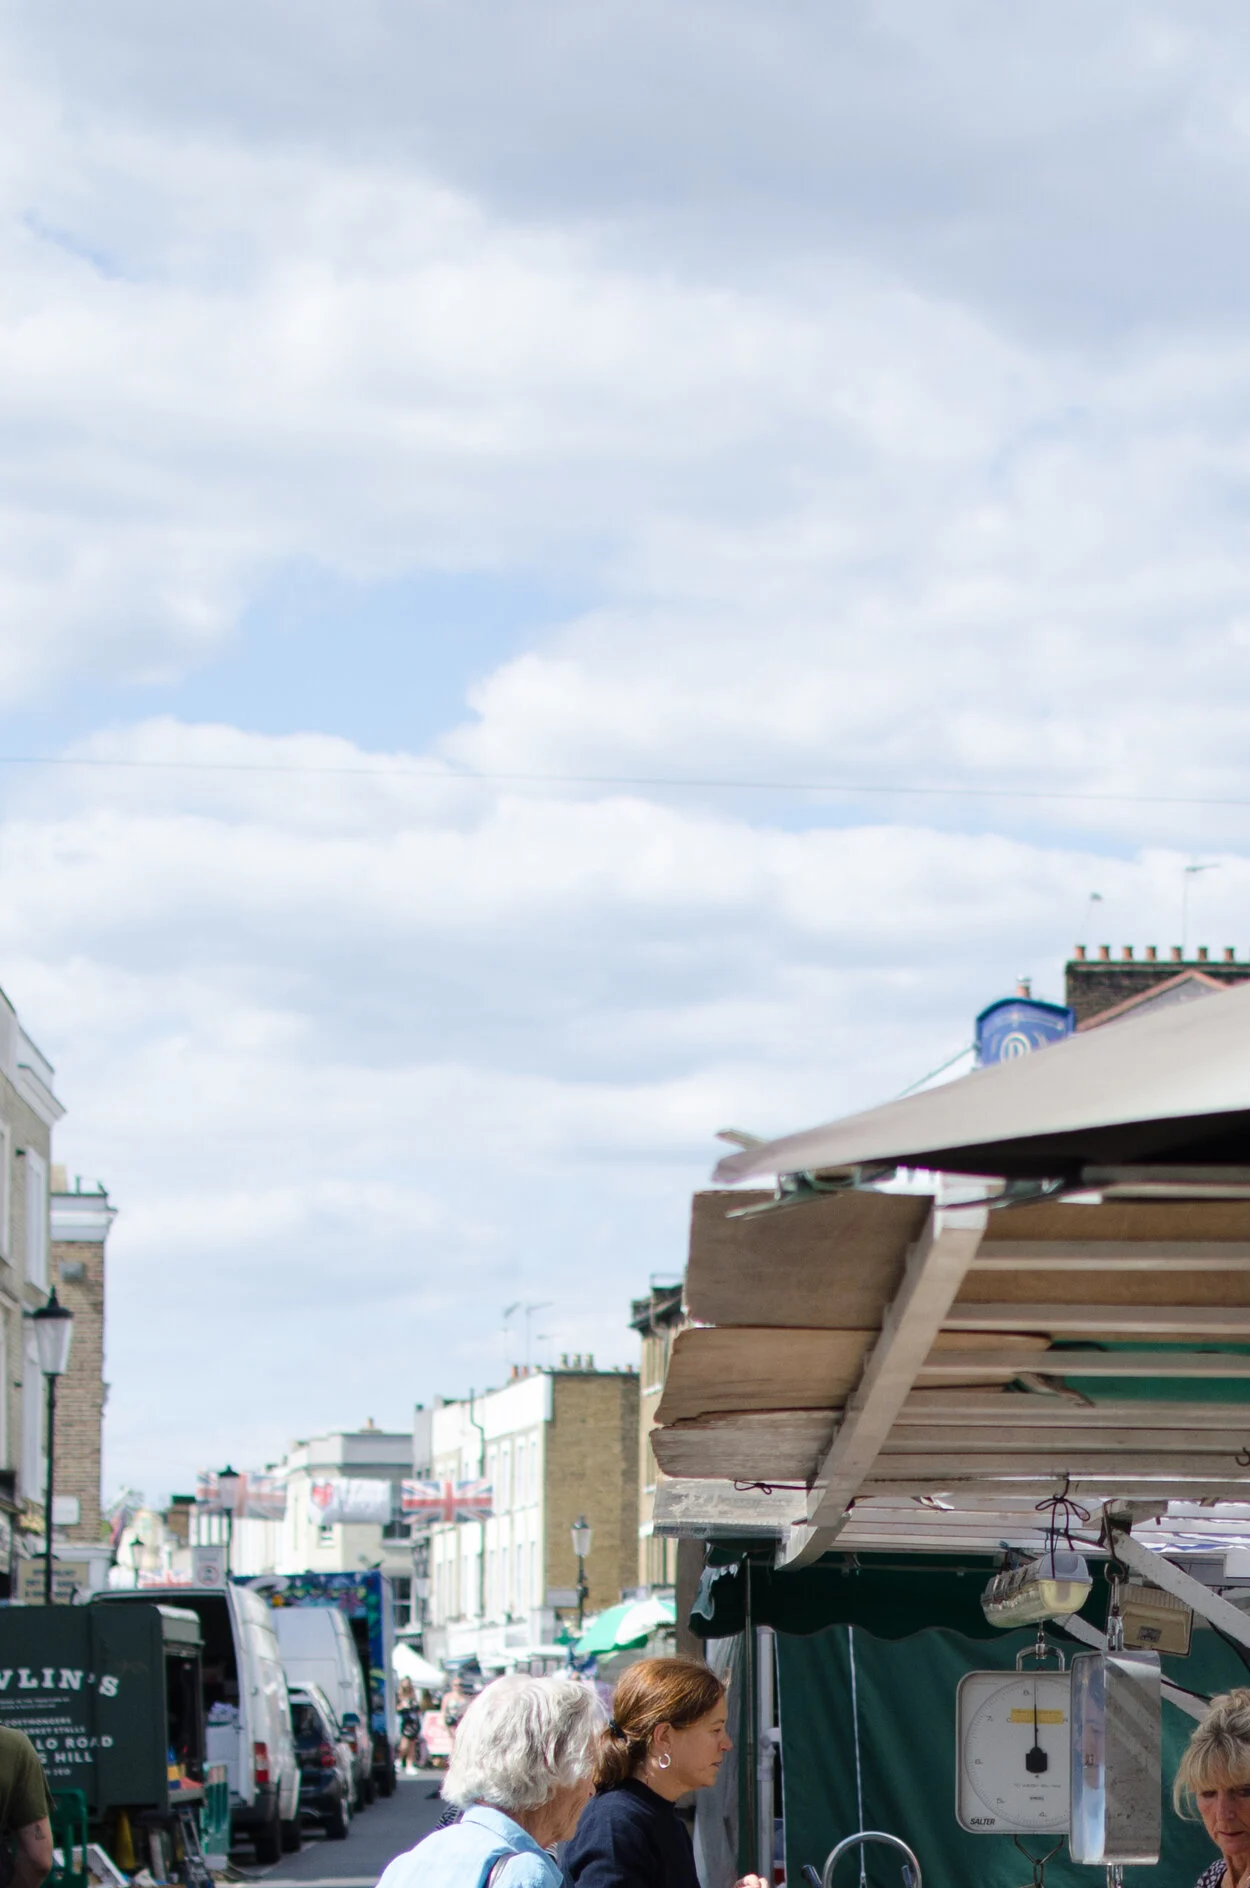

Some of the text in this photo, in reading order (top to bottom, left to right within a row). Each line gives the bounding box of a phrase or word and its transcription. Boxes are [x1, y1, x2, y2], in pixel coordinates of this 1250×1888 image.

[65, 1735, 113, 1750] ROAD
[55, 1751, 93, 1764] HILL
[969, 1817, 996, 1826] SALTER
